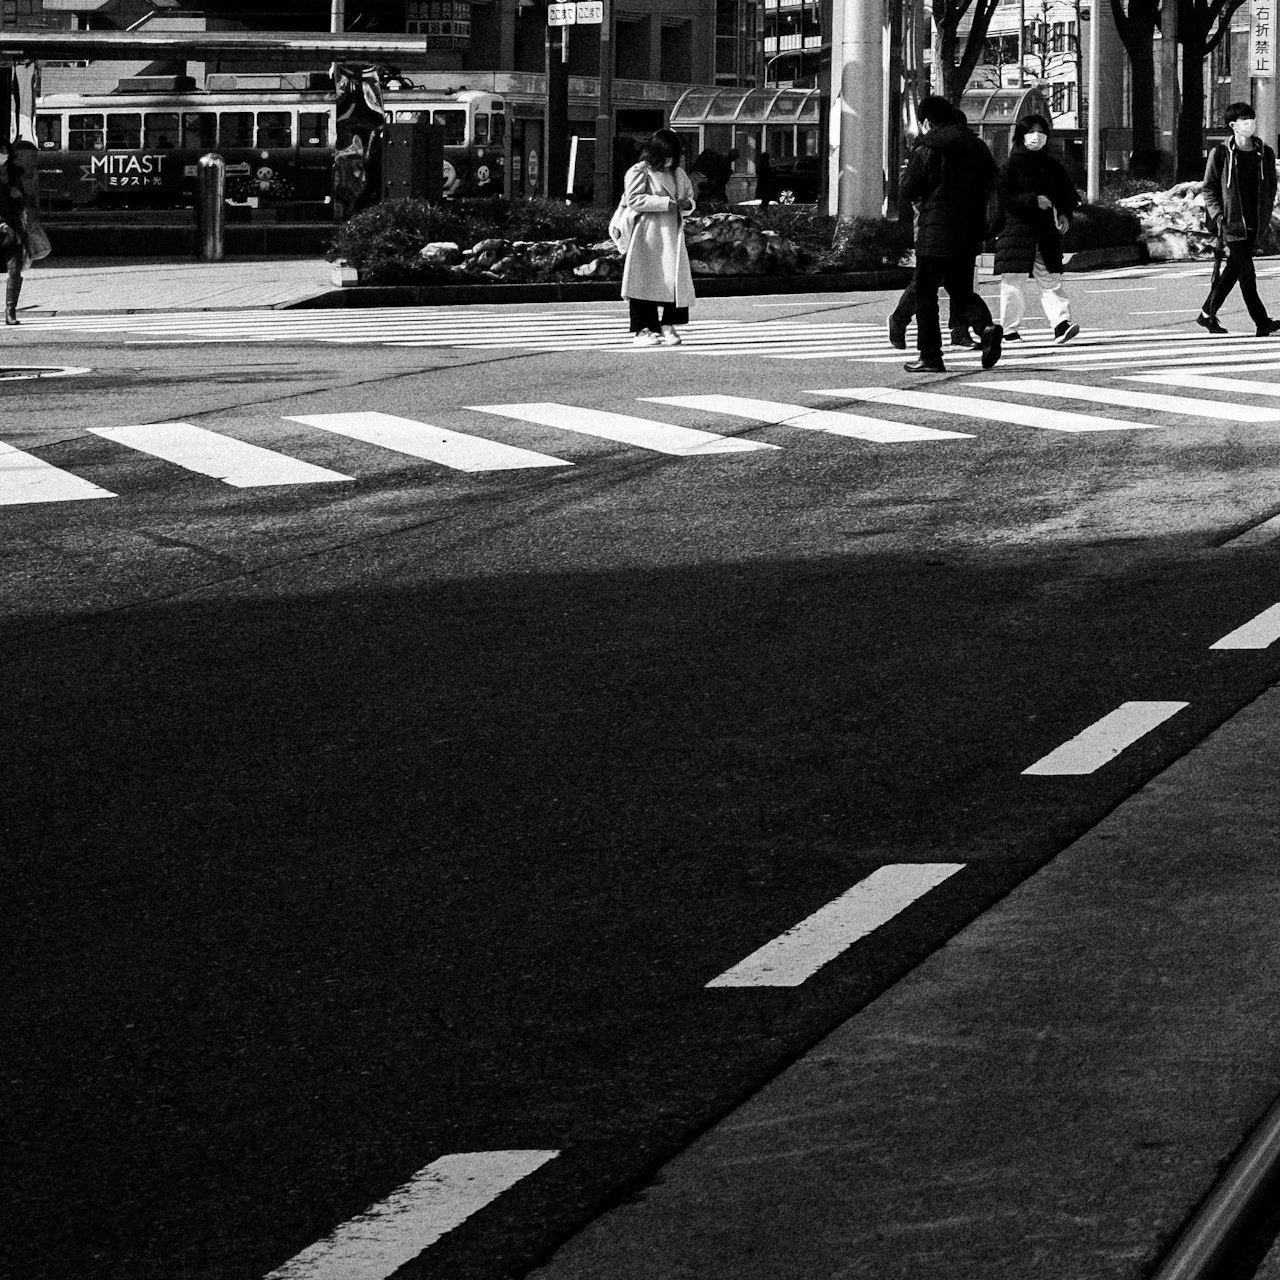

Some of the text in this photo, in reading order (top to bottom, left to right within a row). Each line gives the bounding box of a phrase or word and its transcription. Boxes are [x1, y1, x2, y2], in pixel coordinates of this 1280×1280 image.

[579, 7, 601, 19] ここまで
[1254, 6, 1270, 71] 右折禁止
[91, 154, 167, 174] MITAST
[109, 176, 162, 186] ミタスト光
